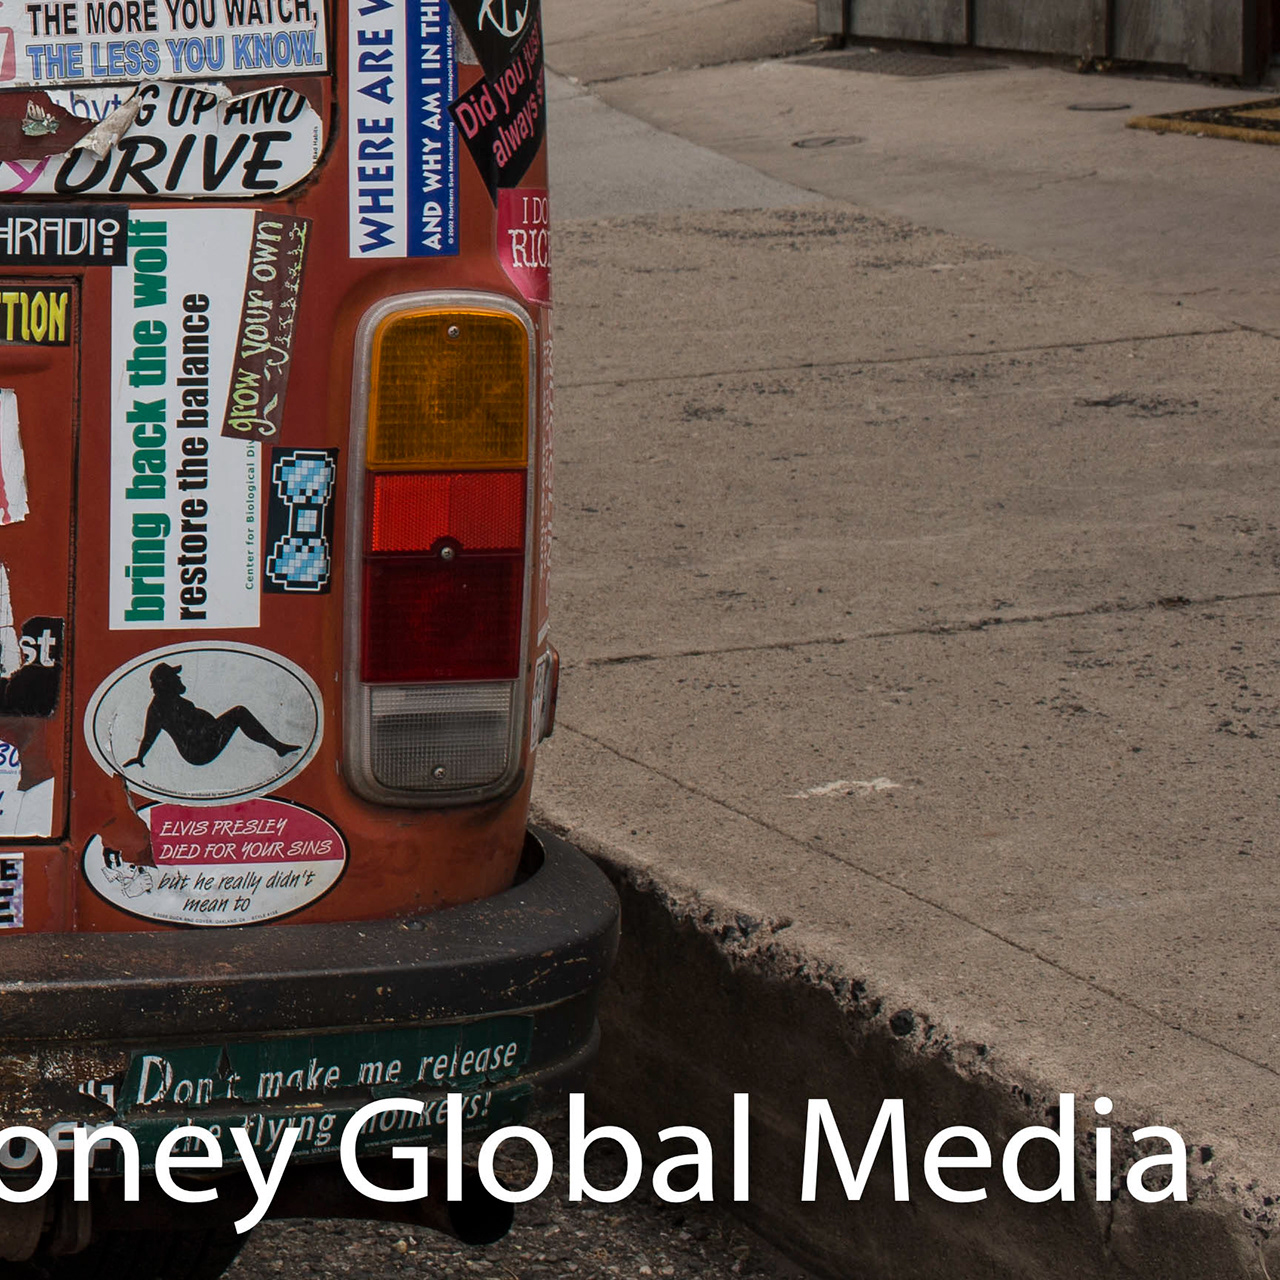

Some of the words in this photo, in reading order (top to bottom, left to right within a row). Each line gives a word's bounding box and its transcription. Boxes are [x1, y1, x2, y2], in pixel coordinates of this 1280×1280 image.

[26, 44, 84, 81] THE
[91, 40, 160, 78] LESS
[166, 36, 225, 74] YOU
[231, 31, 324, 71] KNOW.
[27, 3, 77, 37] THE
[86, 0, 158, 34] MORE
[357, 28, 394, 105] ARE
[357, 117, 394, 254] WHERE
[129, 219, 168, 308] wolf
[125, 319, 168, 389] the
[125, 397, 168, 500] back
[124, 512, 171, 622] bring
